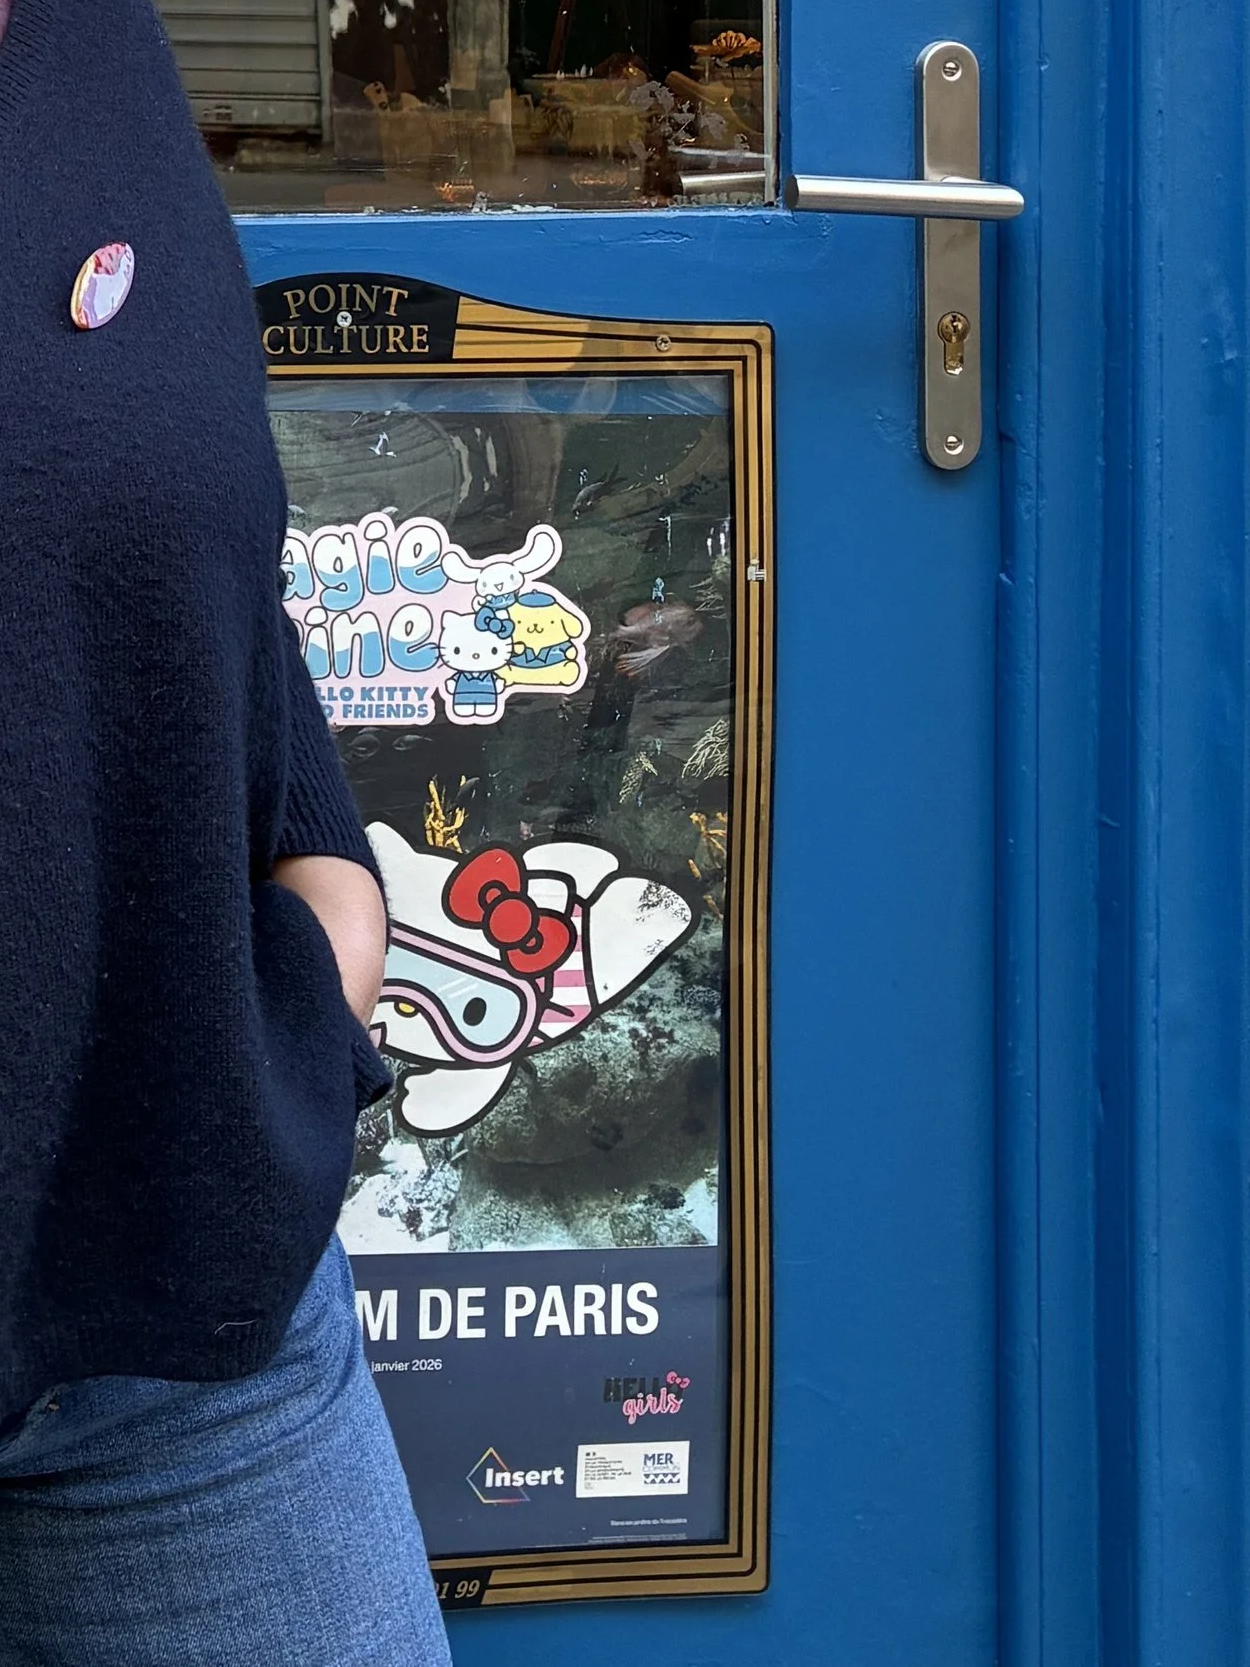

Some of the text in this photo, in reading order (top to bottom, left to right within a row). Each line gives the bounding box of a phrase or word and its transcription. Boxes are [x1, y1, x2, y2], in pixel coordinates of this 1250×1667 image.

[282, 283, 409, 320] POINT
[262, 324, 430, 355] CULTURE
[281, 520, 449, 613] agie
[296, 603, 440, 680] ine
[314, 686, 430, 701] LLO KITTY
[342, 704, 429, 719] FRIENDS
[418, 1287, 486, 1340] DE
[504, 1282, 660, 1338] PARIS
[371, 1359, 443, 1374] janvier 2026
[622, 1387, 684, 1425] girls
[643, 1452, 674, 1466] MER
[485, 1466, 565, 1488] Insert
[454, 1579, 481, 1599] 99
